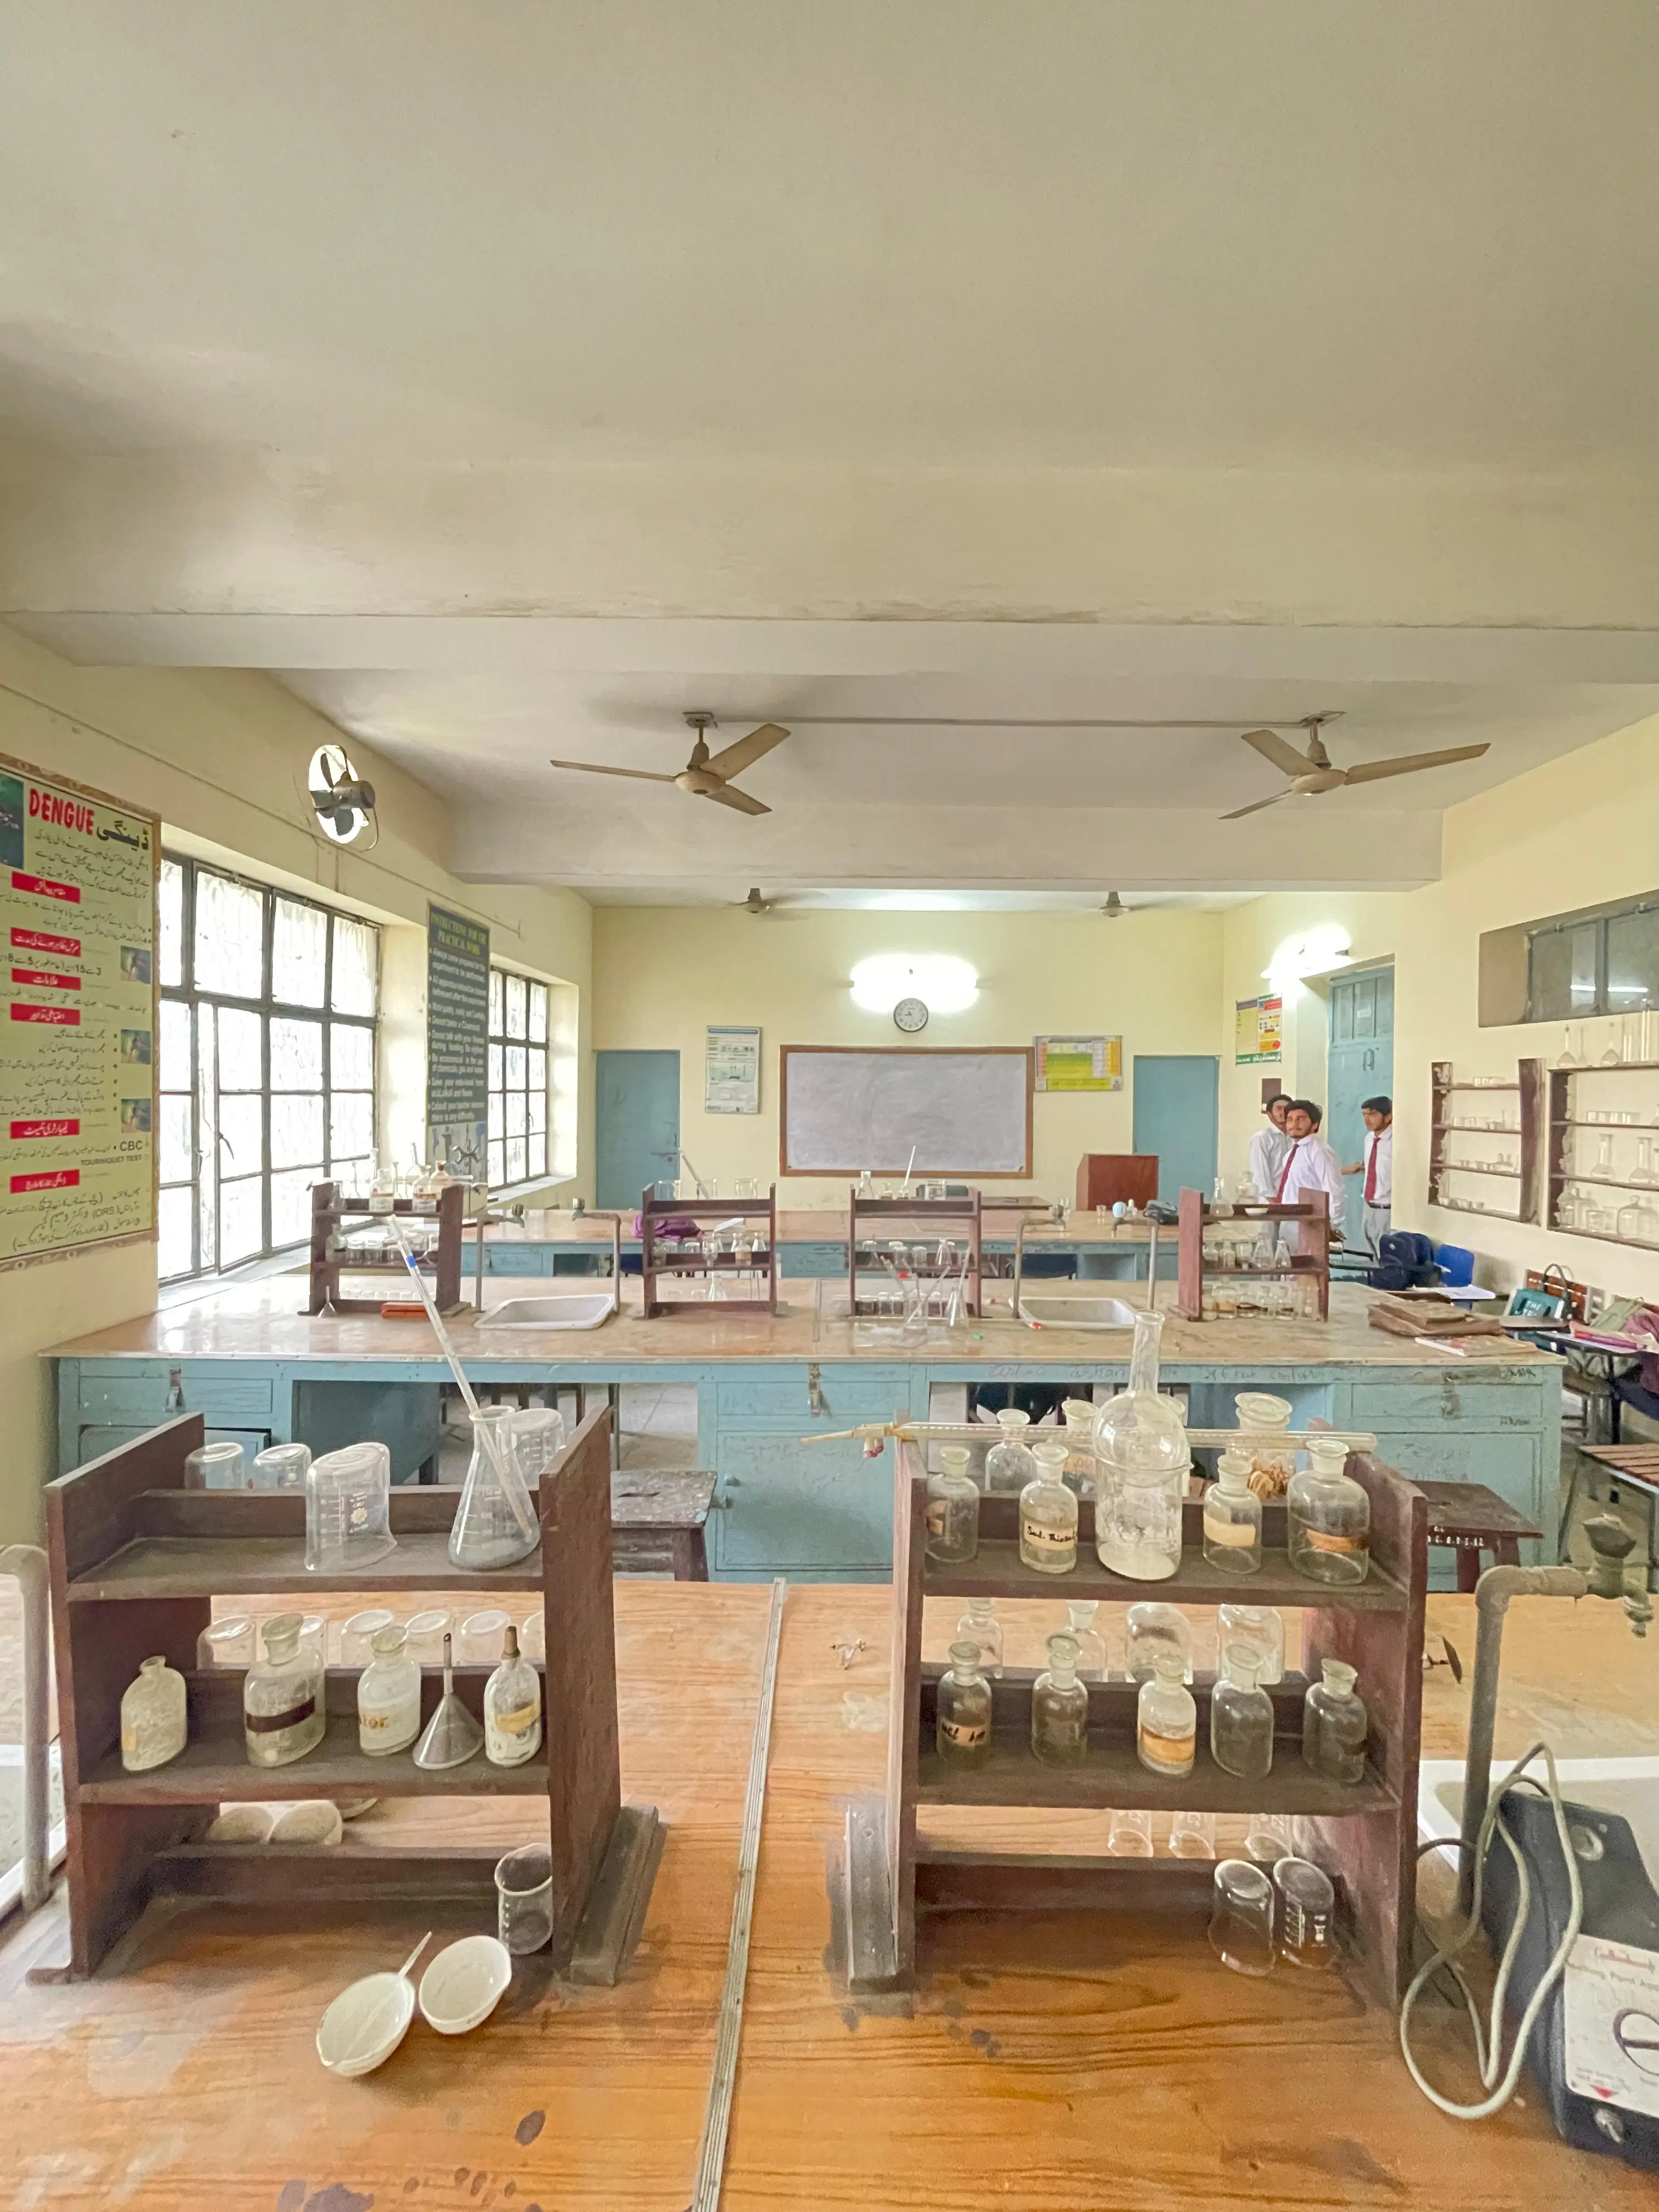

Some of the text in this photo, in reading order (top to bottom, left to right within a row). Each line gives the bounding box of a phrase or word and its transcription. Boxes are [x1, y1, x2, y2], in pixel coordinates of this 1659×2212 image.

[29, 788, 95, 836] DENGUE
[97, 820, 149, 851] ڈینگی
[120, 1141, 143, 1150] CBC
[126, 1154, 142, 1164] TEST
